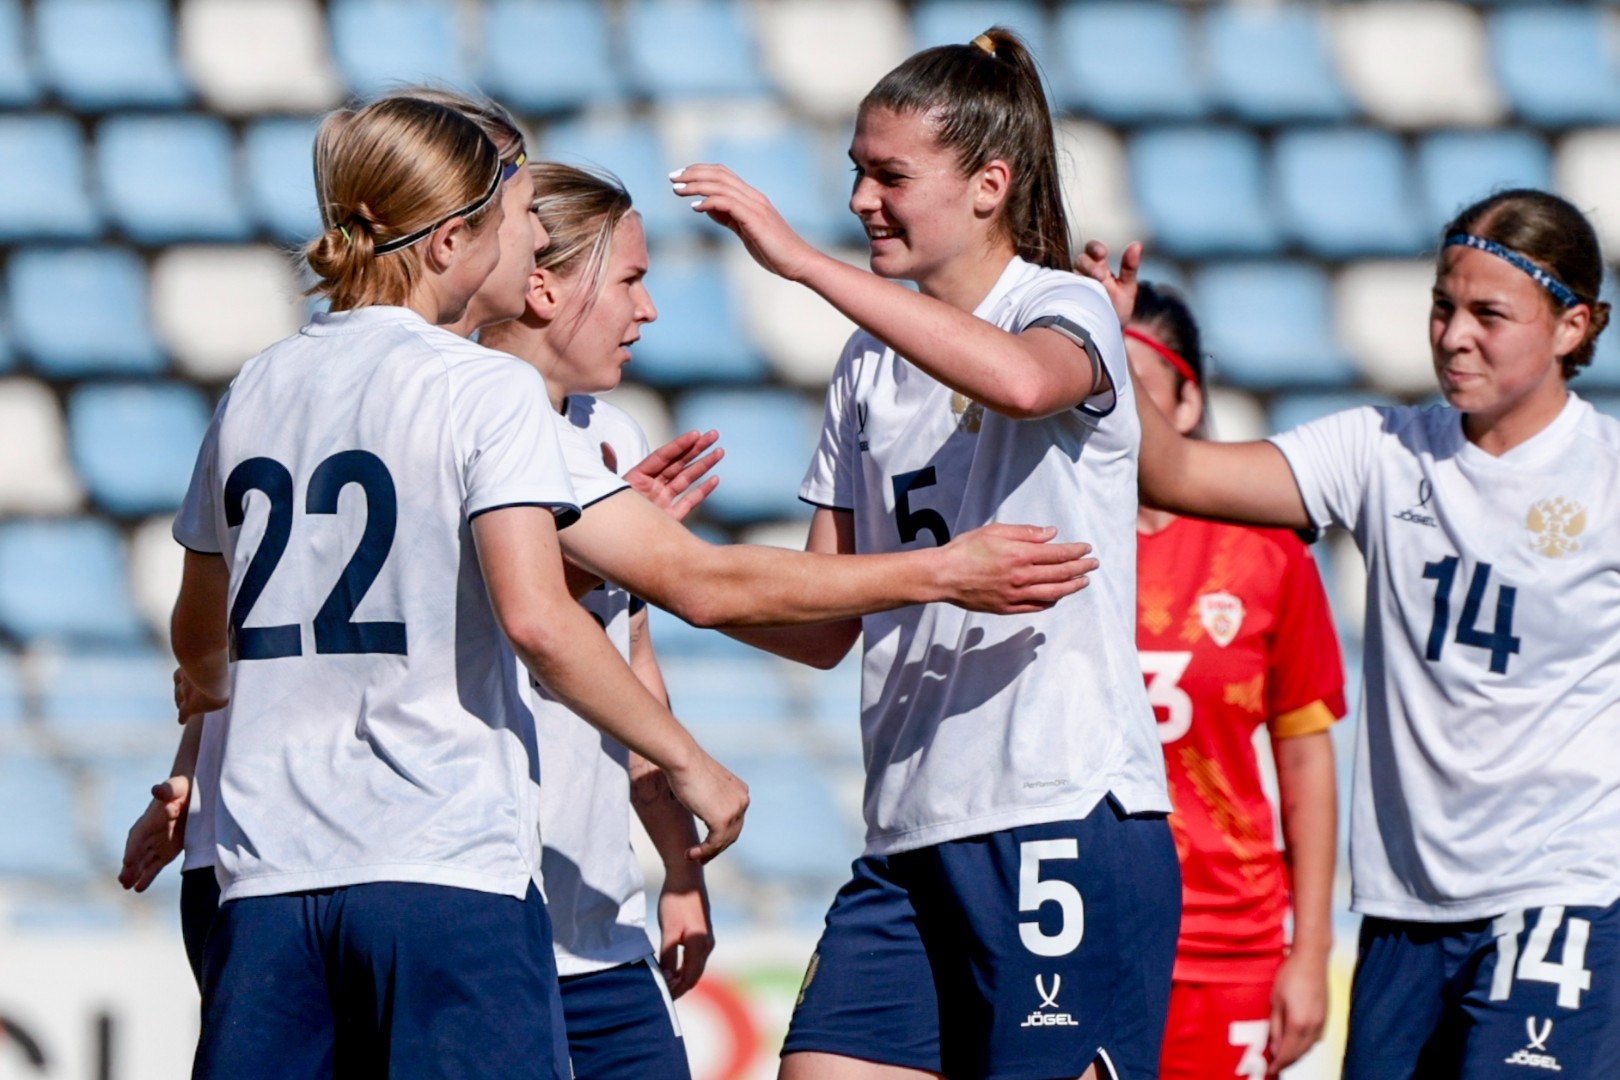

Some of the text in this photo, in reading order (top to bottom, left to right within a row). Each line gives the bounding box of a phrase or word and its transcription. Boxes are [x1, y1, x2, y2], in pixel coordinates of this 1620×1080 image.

[892, 466, 951, 547] 5
[1392, 509, 1438, 527] JÖGEL
[225, 449, 408, 662] 22
[1422, 555, 1520, 675] 14
[1018, 838, 1084, 957] 5
[1488, 905, 1592, 1010] 14
[1020, 1011, 1079, 1027] JÖGEL
[1504, 1050, 1562, 1071] JÖGEL
